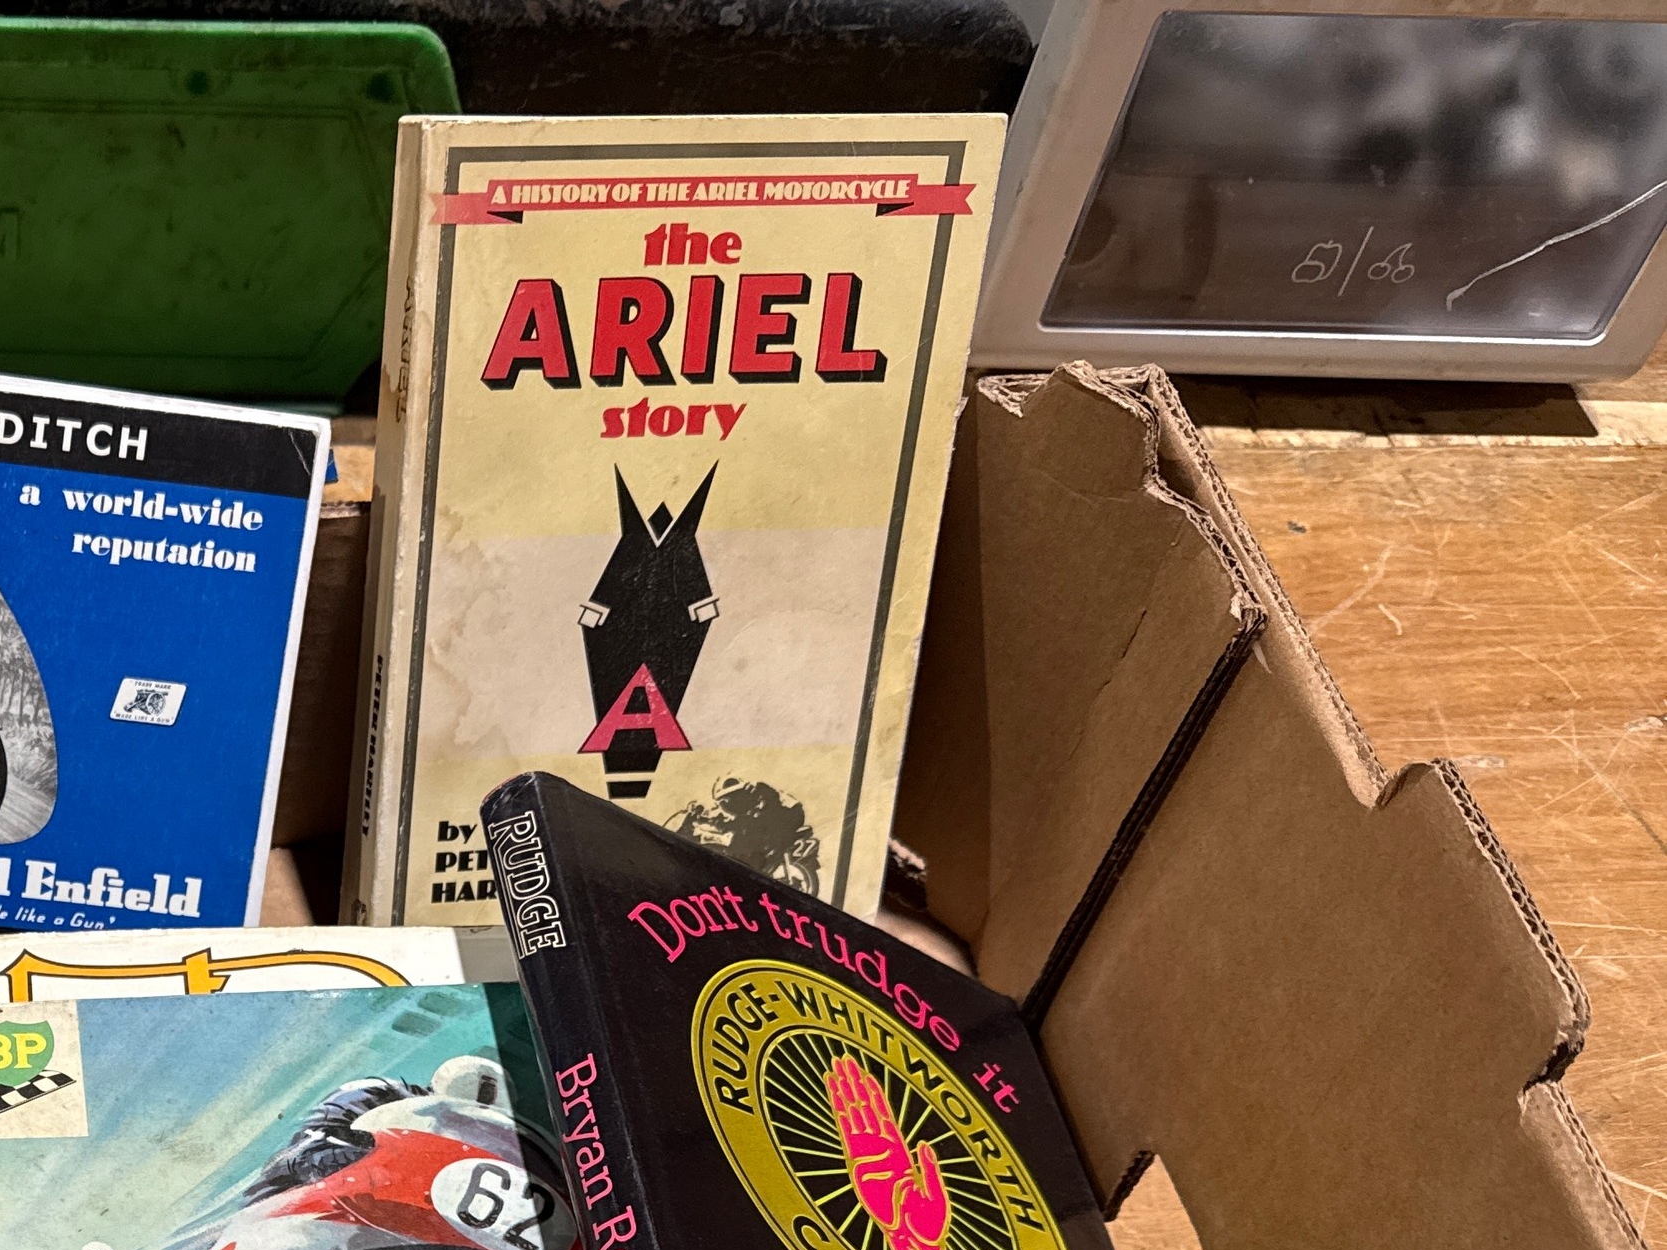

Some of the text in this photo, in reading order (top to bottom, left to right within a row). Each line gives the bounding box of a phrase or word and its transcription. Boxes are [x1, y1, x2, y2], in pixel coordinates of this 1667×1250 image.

[491, 178, 910, 204] A HISTORY OF THE ARIEL MOTORCYCLE
[644, 223, 742, 267] the
[480, 272, 888, 390] ARIEL
[601, 399, 746, 440] story
[19, 484, 264, 532] a world-wide
[71, 529, 257, 575] reputation
[577, 662, 693, 754] A
[438, 820, 477, 847] by
[794, 839, 817, 857] 27
[435, 851, 488, 874] PET
[487, 810, 567, 959] RUDGE
[20, 860, 201, 919] Enfield
[16, 905, 46, 925] like
[53, 916, 64, 926] a
[627, 886, 1021, 1114] Don't trudge it
[556, 1053, 614, 1210] Bryan
